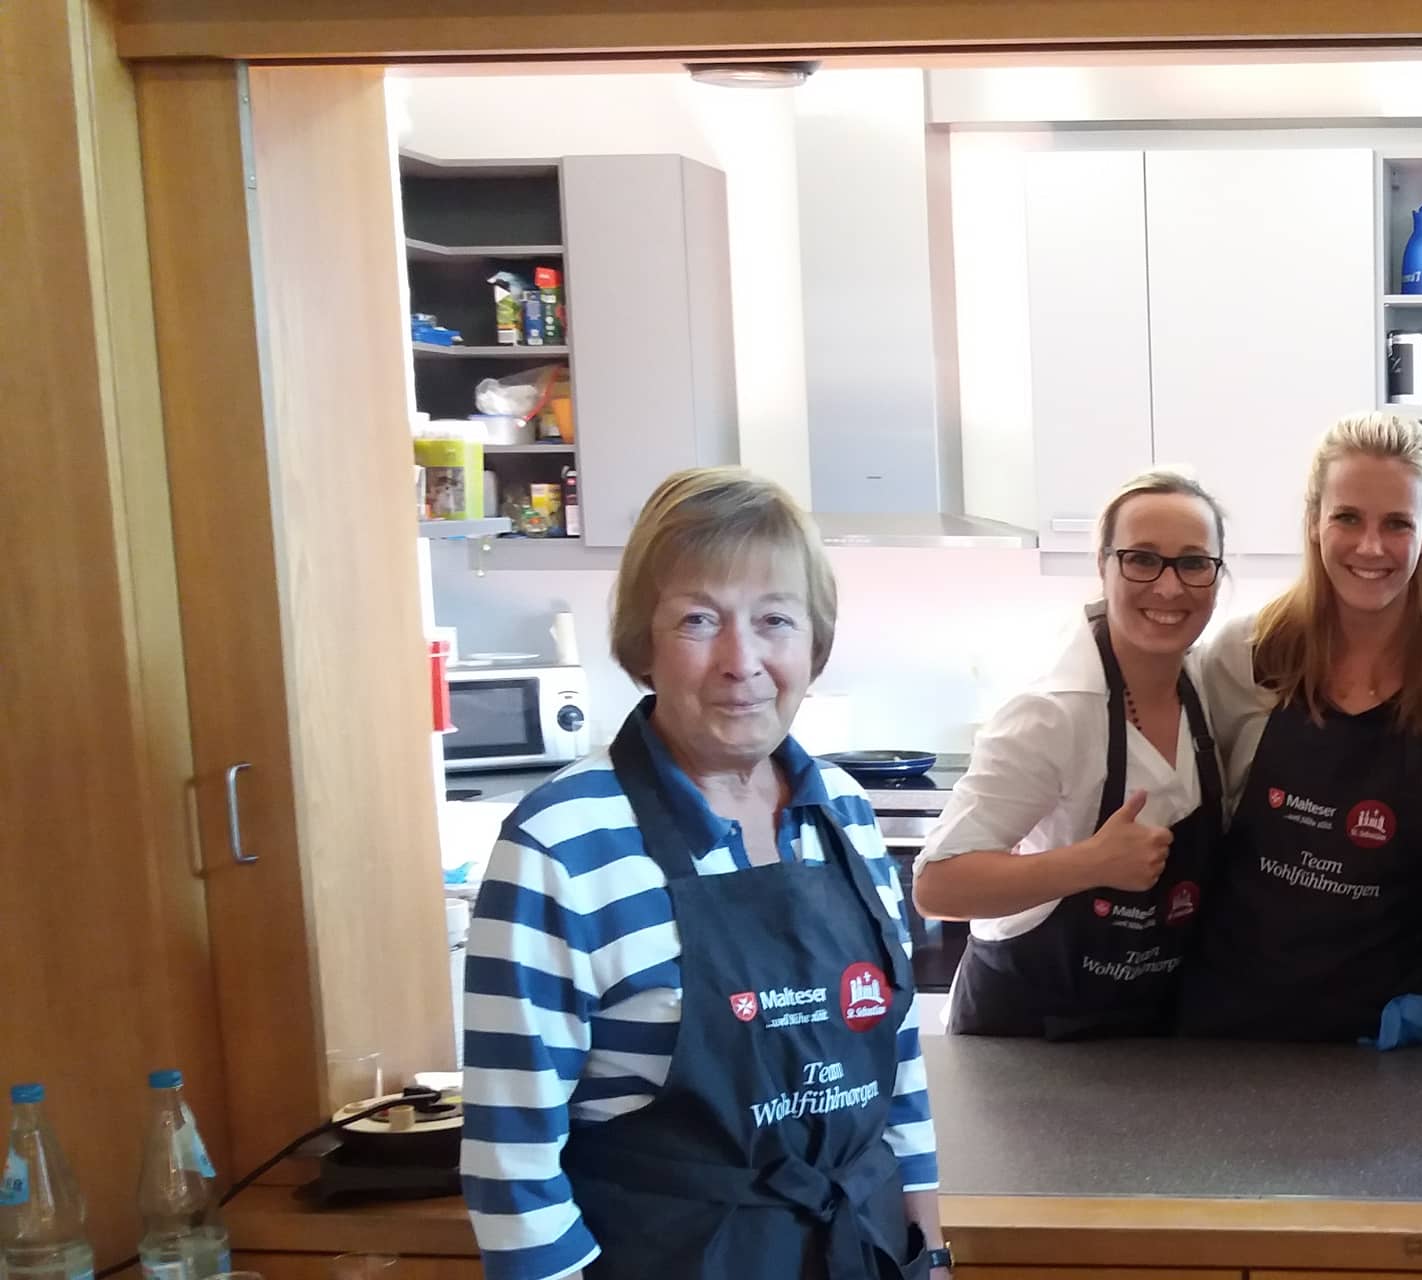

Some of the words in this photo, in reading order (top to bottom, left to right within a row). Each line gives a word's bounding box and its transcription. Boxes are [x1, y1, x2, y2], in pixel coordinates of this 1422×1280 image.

[1286, 793, 1337, 817] Malteser
[1300, 850, 1343, 874] Team
[1259, 856, 1380, 900] Wohlfühlmorgen
[759, 987, 827, 1010] Malteser
[802, 1061, 844, 1086] Team
[750, 1080, 879, 1128] Wohlfühlmorgen
